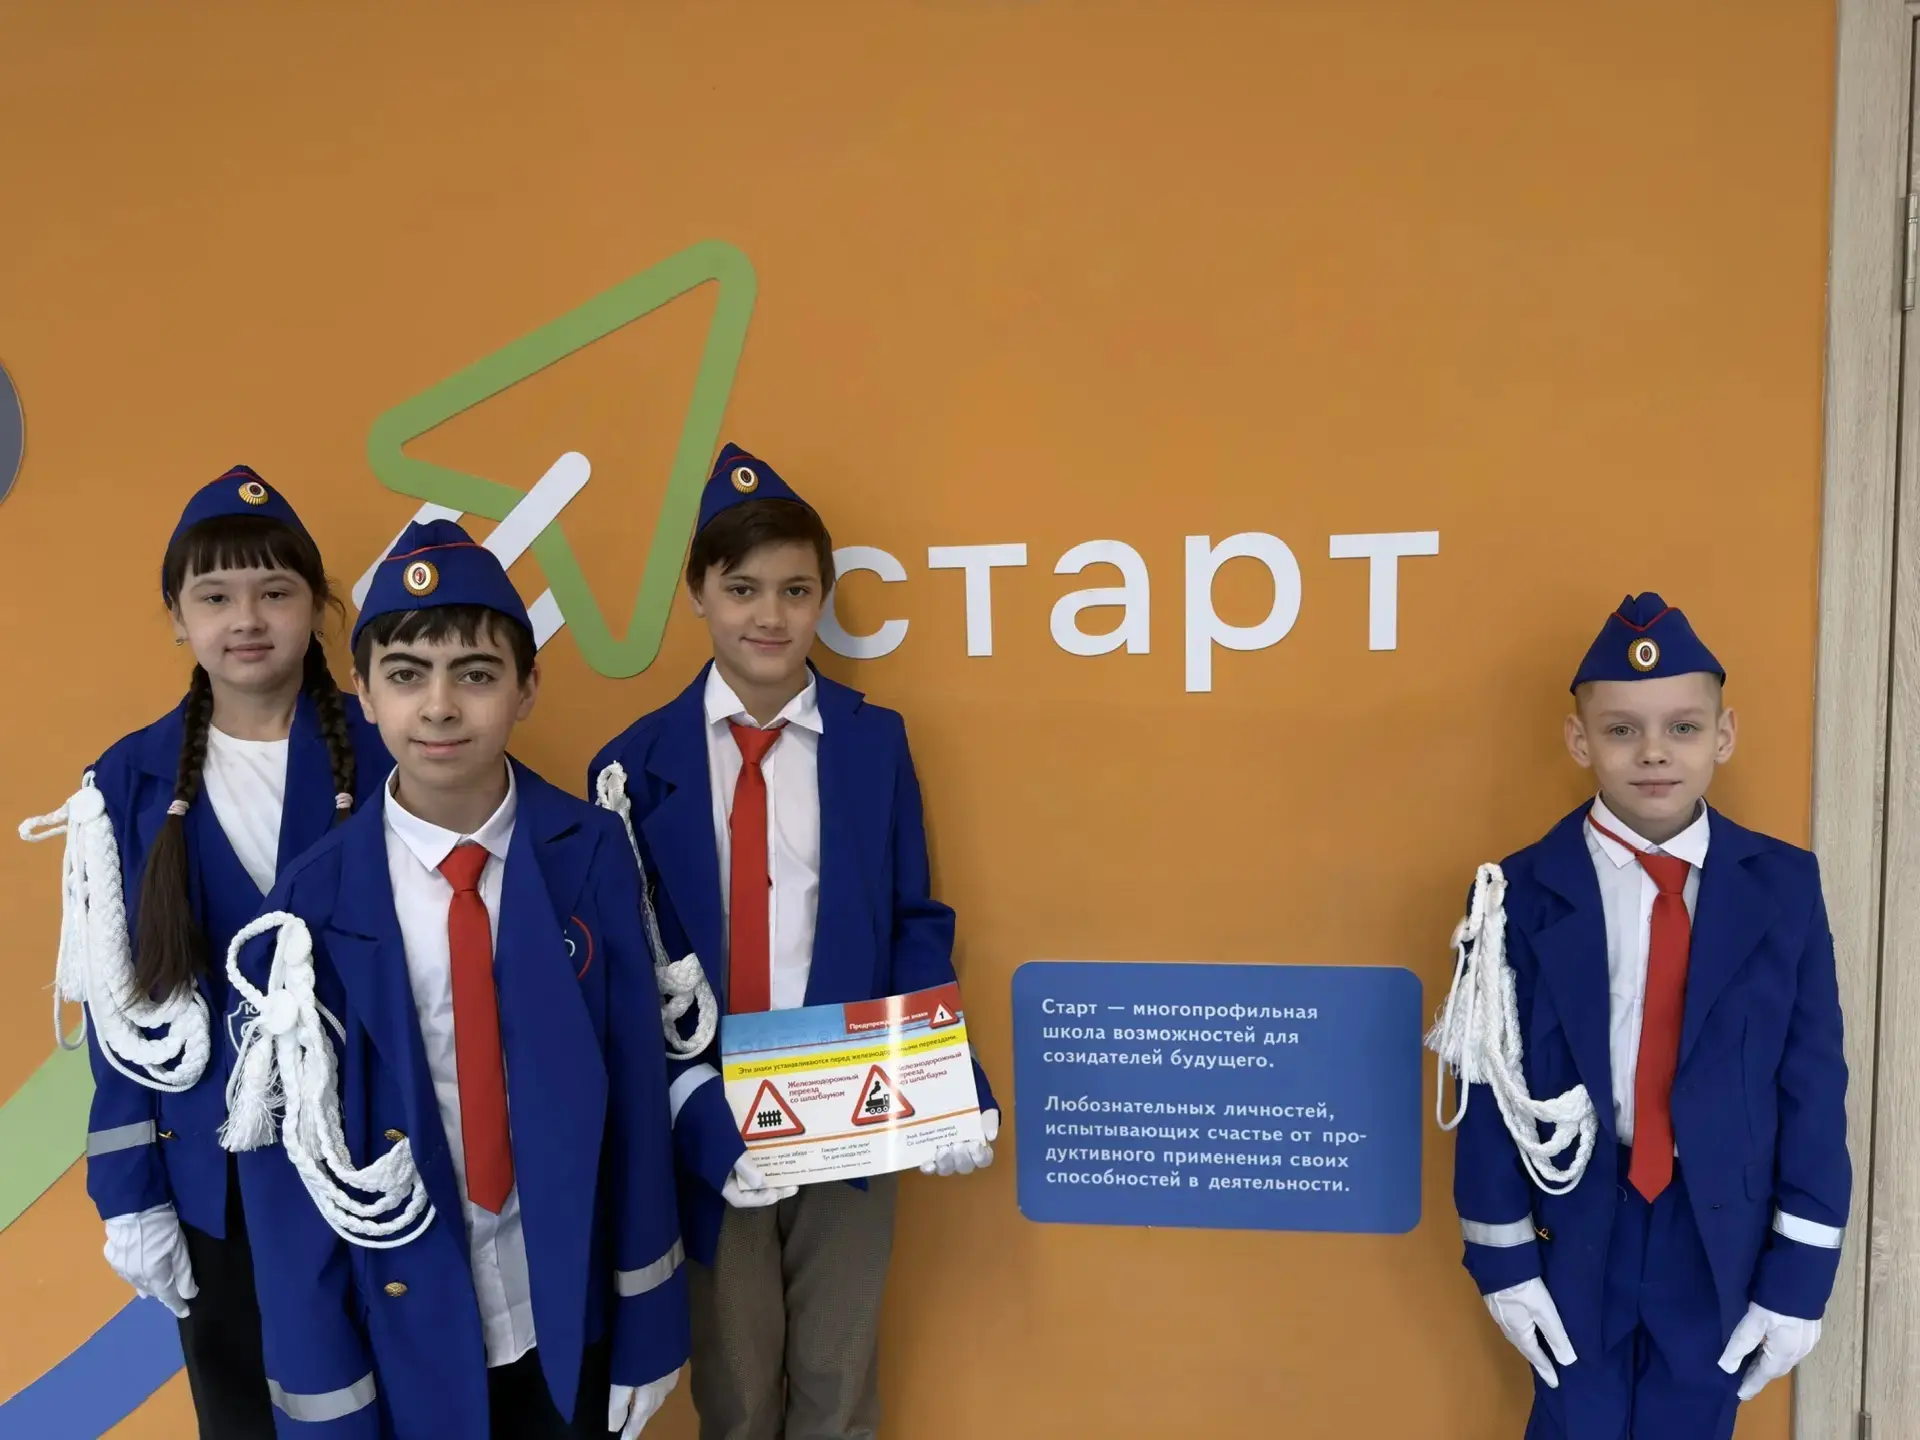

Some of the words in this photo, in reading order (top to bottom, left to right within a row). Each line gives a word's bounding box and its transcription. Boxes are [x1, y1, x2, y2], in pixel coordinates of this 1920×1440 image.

[815, 531, 1439, 692] старт
[938, 1010, 945, 1020] 1
[1042, 998, 1098, 1018] Старт
[1133, 1002, 1318, 1021] многопрофильная
[1043, 1025, 1106, 1040] школа
[1113, 1024, 1255, 1043] возможностей
[1263, 1031, 1299, 1046] для
[738, 1067, 753, 1075] Эти
[753, 1065, 772, 1074] знаки
[773, 1058, 829, 1072] устанавливаются
[830, 1055, 851, 1065] перед
[1043, 1047, 1163, 1065] созидателей
[1170, 1047, 1275, 1070] будущего.
[787, 1073, 859, 1089] Железнодорожный
[909, 1070, 948, 1084] шлагбаума
[789, 1086, 820, 1097] переезд
[789, 1096, 799, 1104] со
[799, 1089, 845, 1103] шлагбаумом
[1044, 1095, 1216, 1115] Любознательных
[1223, 1102, 1335, 1122] личностей,
[1045, 1124, 1200, 1141] испытывающих
[1207, 1128, 1283, 1141] счастье
[1290, 1130, 1312, 1142] от
[1322, 1131, 1367, 1146] про-
[1045, 1147, 1156, 1163] дуктивного
[1163, 1151, 1282, 1167] применения
[1290, 1155, 1349, 1168] своих
[1046, 1168, 1181, 1187] способностей
[1189, 1176, 1199, 1188] в
[1208, 1177, 1351, 1192] деятельности.
